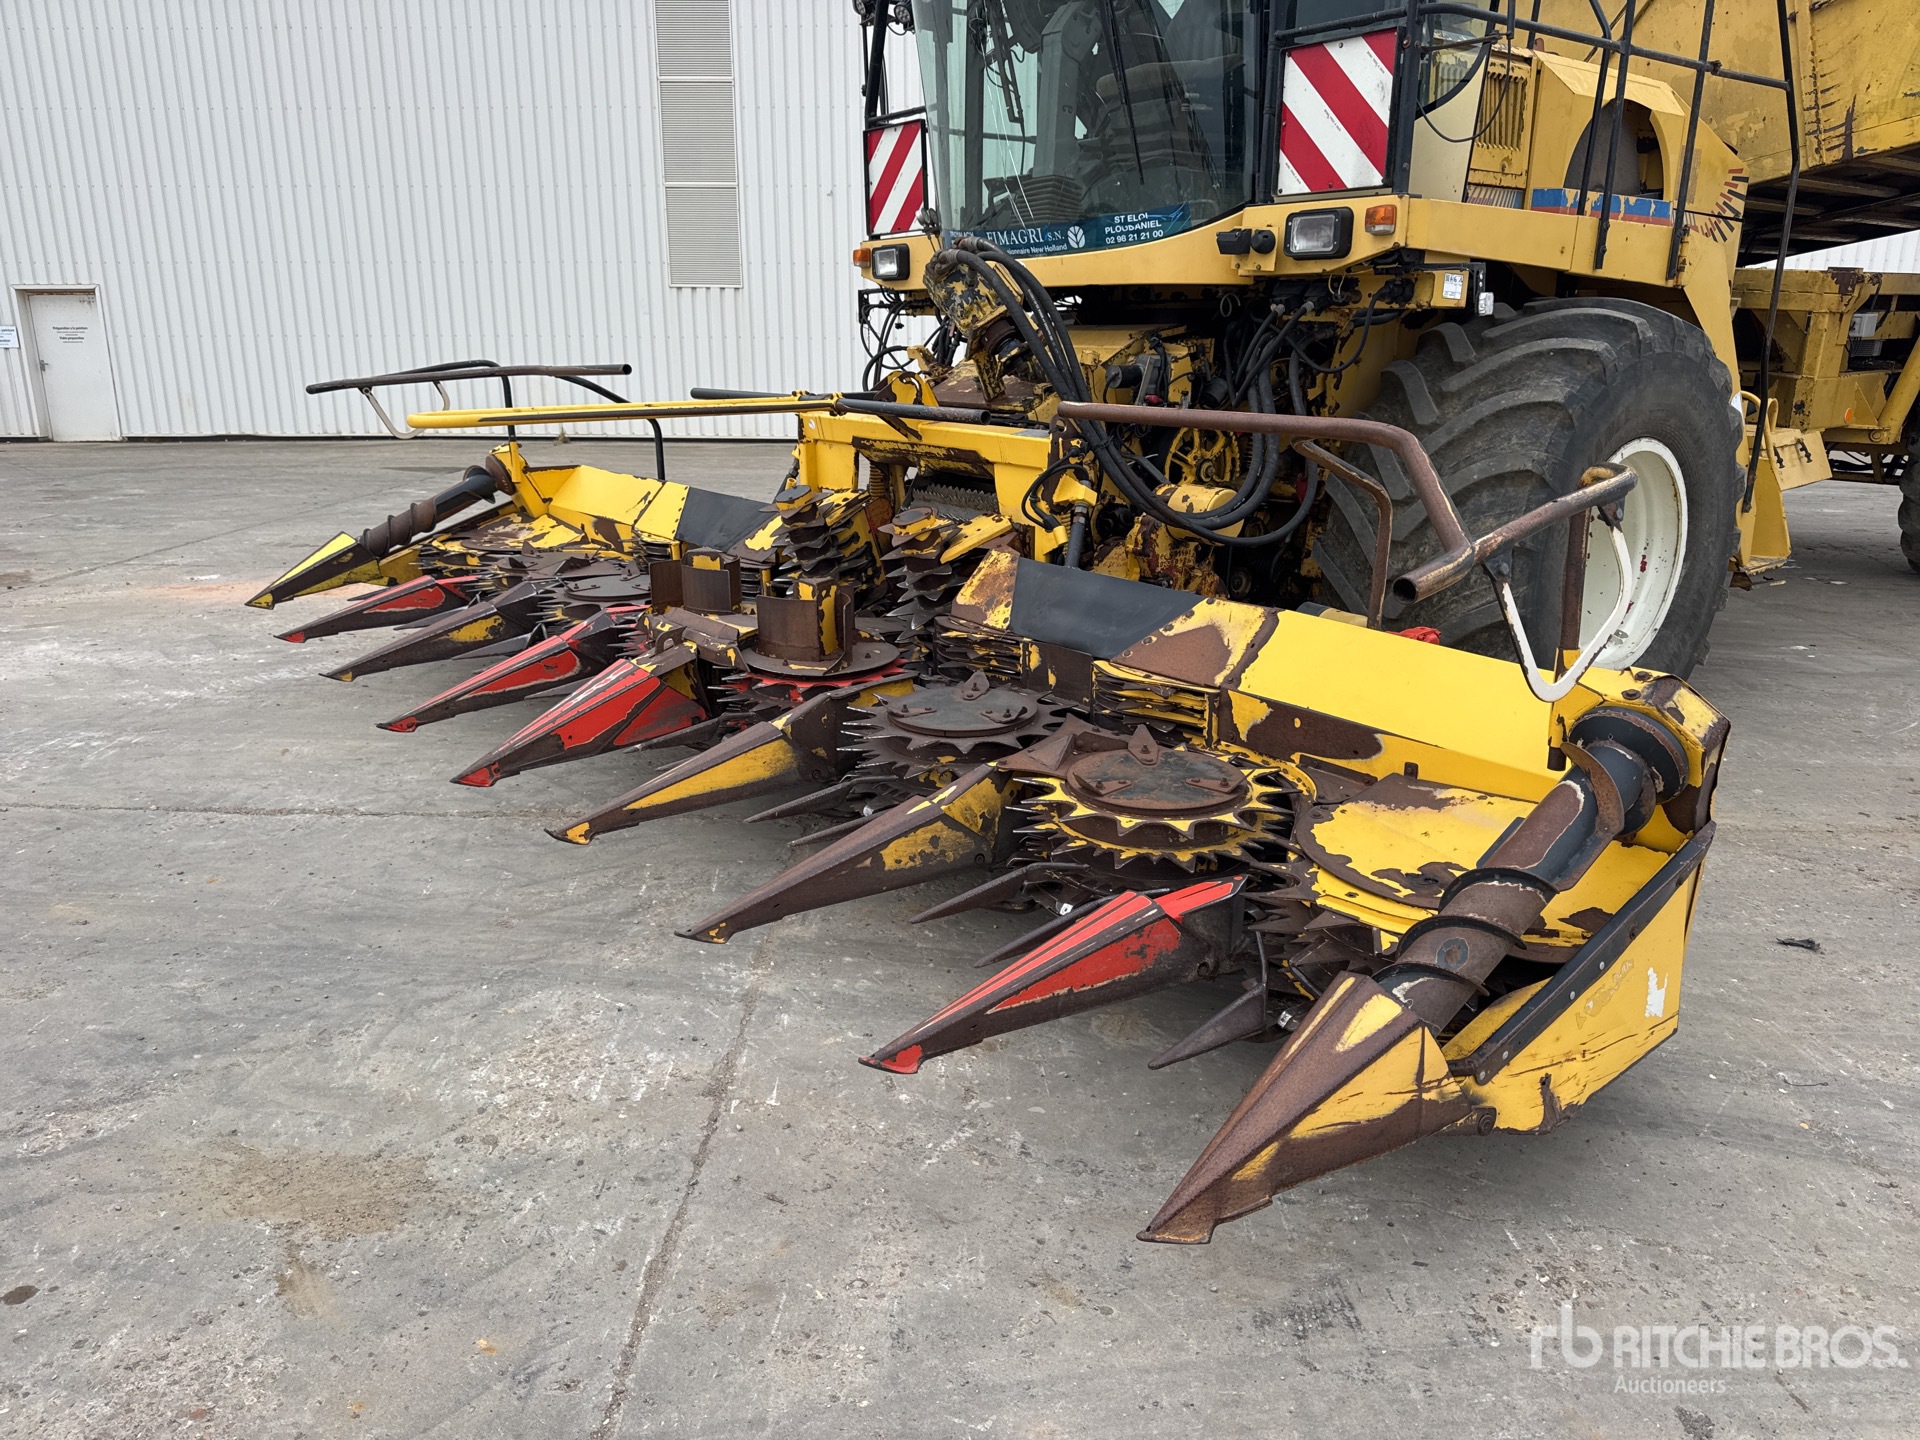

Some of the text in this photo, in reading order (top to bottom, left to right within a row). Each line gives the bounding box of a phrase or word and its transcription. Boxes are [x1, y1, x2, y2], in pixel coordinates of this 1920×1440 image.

[1114, 215, 1125, 224] ST
[1105, 219, 1162, 234] PLOUDANIEL
[1105, 229, 1164, 245] 02 98 21 21 00
[1030, 244, 1045, 253] New
[1044, 242, 1068, 252] Holland
